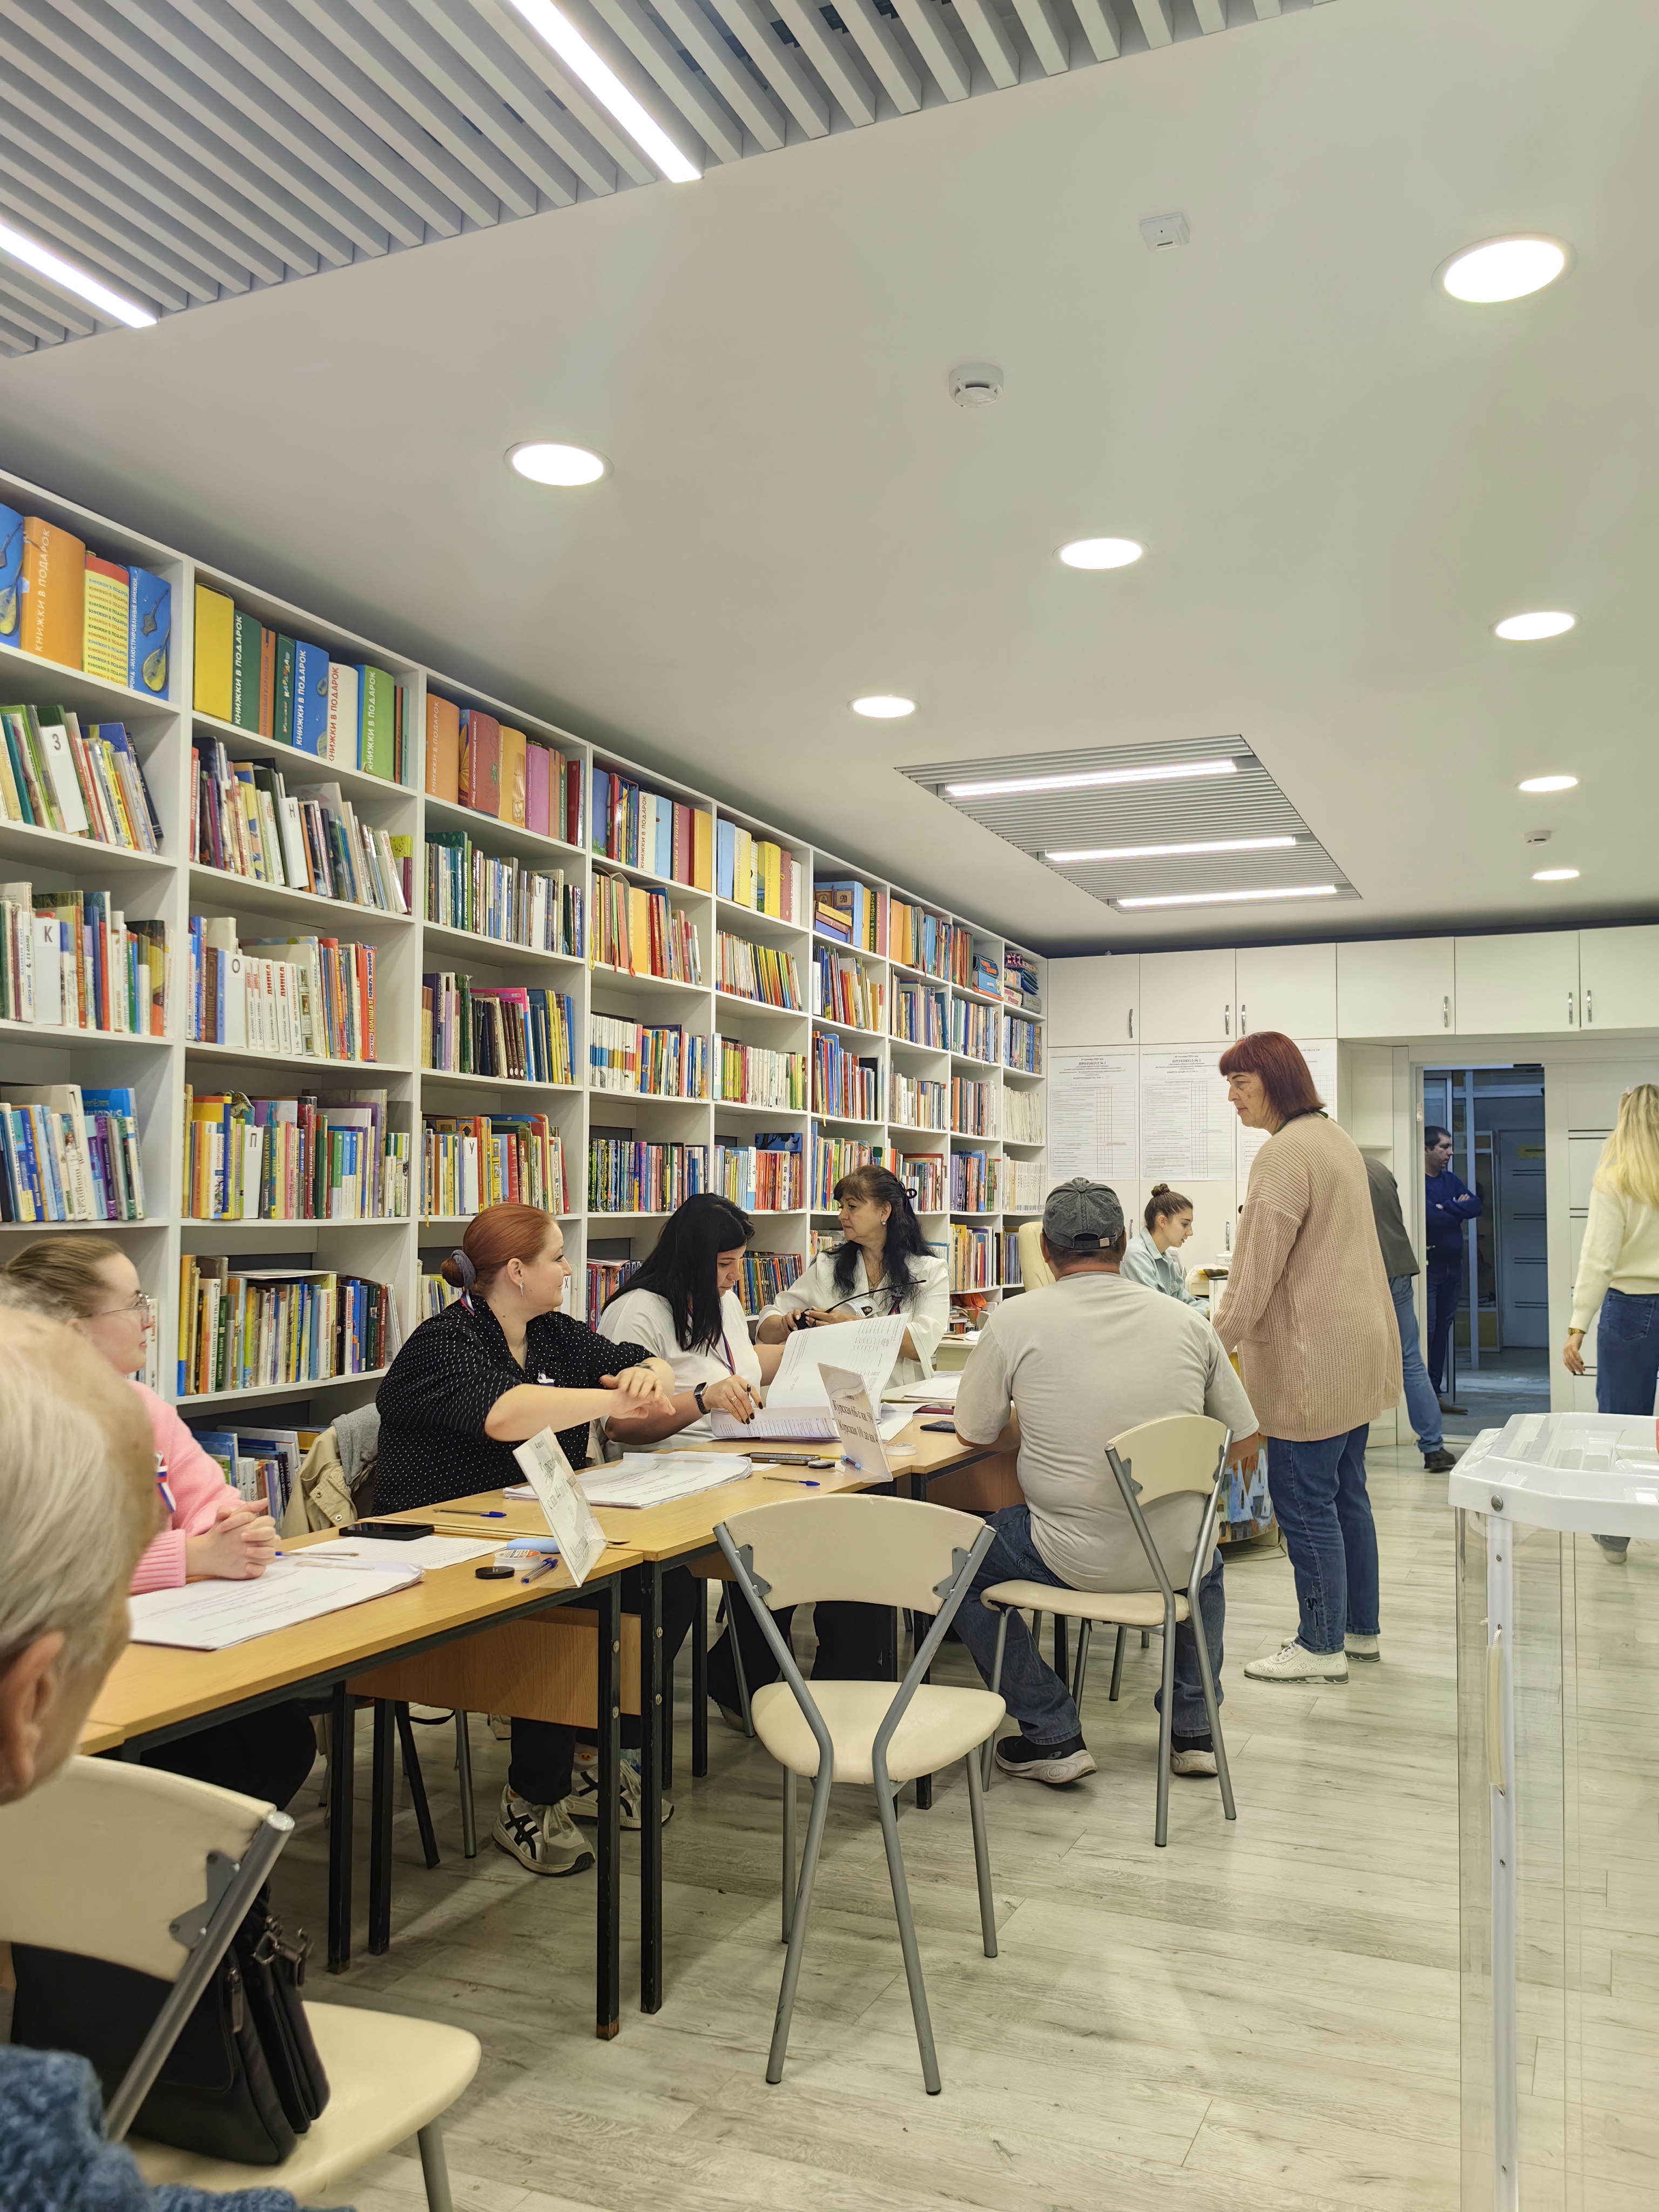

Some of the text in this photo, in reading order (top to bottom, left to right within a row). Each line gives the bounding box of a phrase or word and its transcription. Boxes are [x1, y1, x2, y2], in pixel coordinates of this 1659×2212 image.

[39, 528, 50, 587] ПОДАРОК
[35, 601, 45, 651] КНИЖКИ
[297, 650, 306, 694] ПОДАРОК
[329, 667, 339, 711] ПОДАРОК
[368, 671, 376, 718] ПОДАРОК
[296, 706, 304, 745] КНИЖКИ
[289, 804, 295, 818] Н
[44, 926, 53, 942] К
[232, 959, 240, 973] О
[249, 1133, 257, 1148] П
[469, 1142, 474, 1155] У
[564, 1277, 569, 1289] Х
[832, 1400, 851, 1417] Курская
[838, 1419, 858, 1435] Курская
